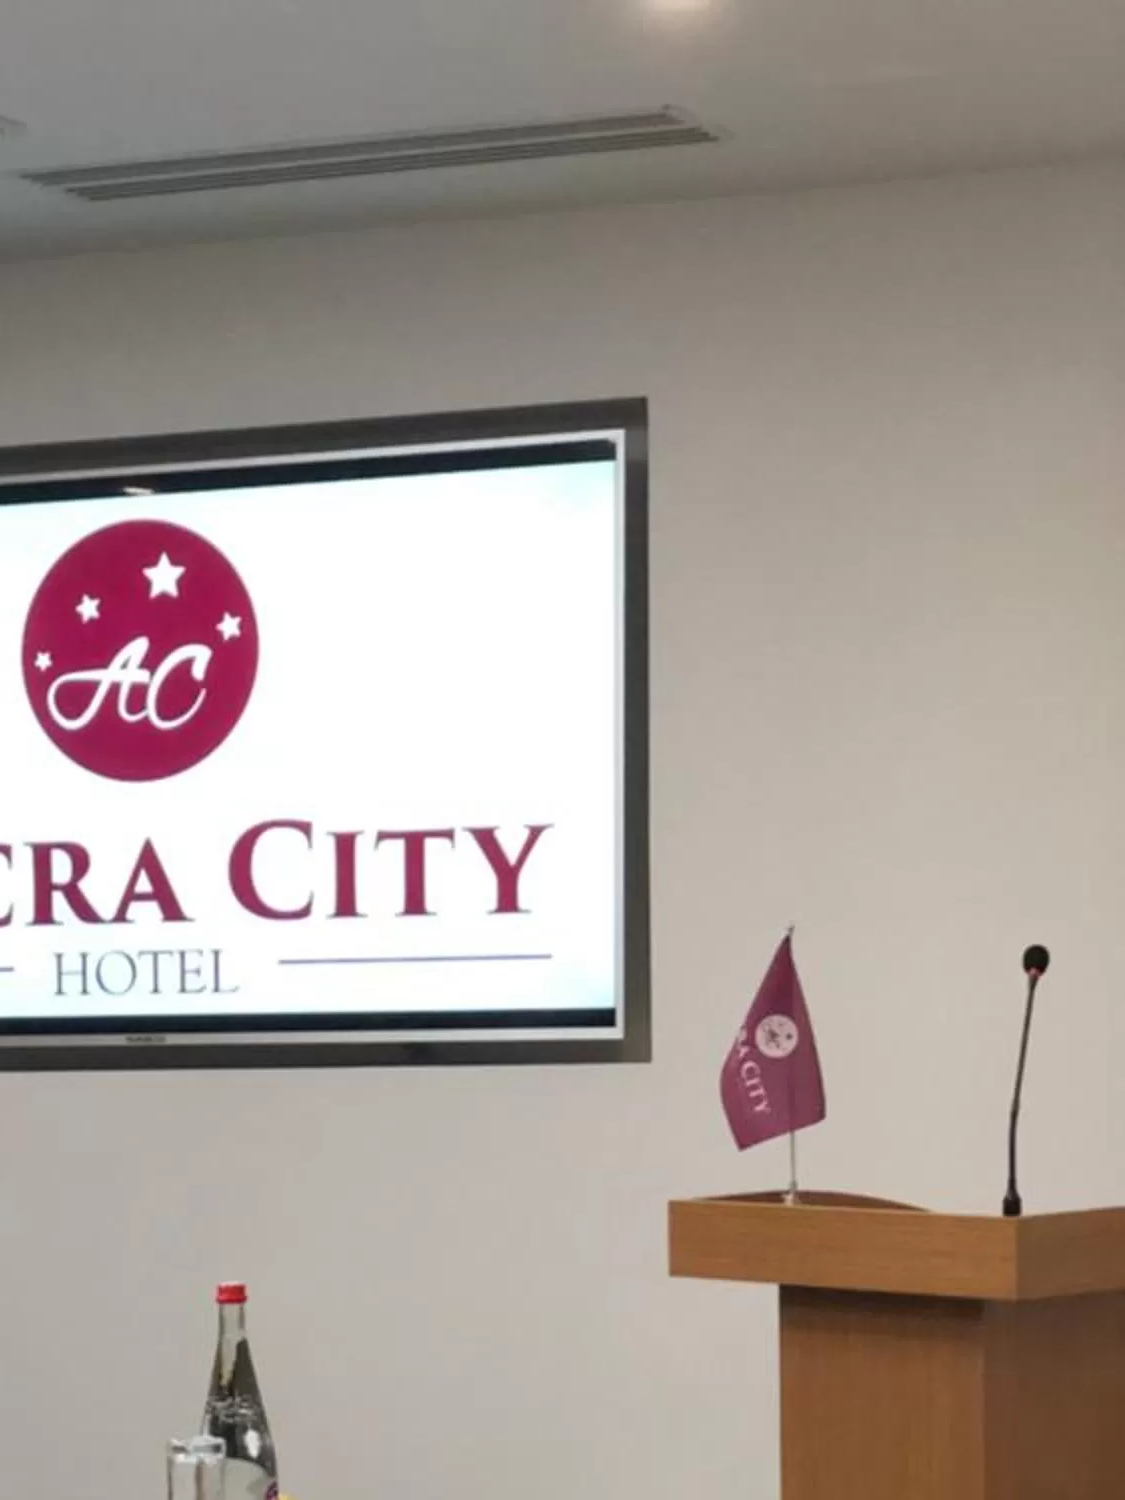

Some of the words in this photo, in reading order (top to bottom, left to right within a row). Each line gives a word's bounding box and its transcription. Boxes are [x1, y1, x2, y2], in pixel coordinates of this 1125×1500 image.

[46, 636, 213, 731] AC
[227, 818, 557, 922] CITY
[53, 949, 242, 997] HOTEL
[740, 1060, 772, 1113] CITY
